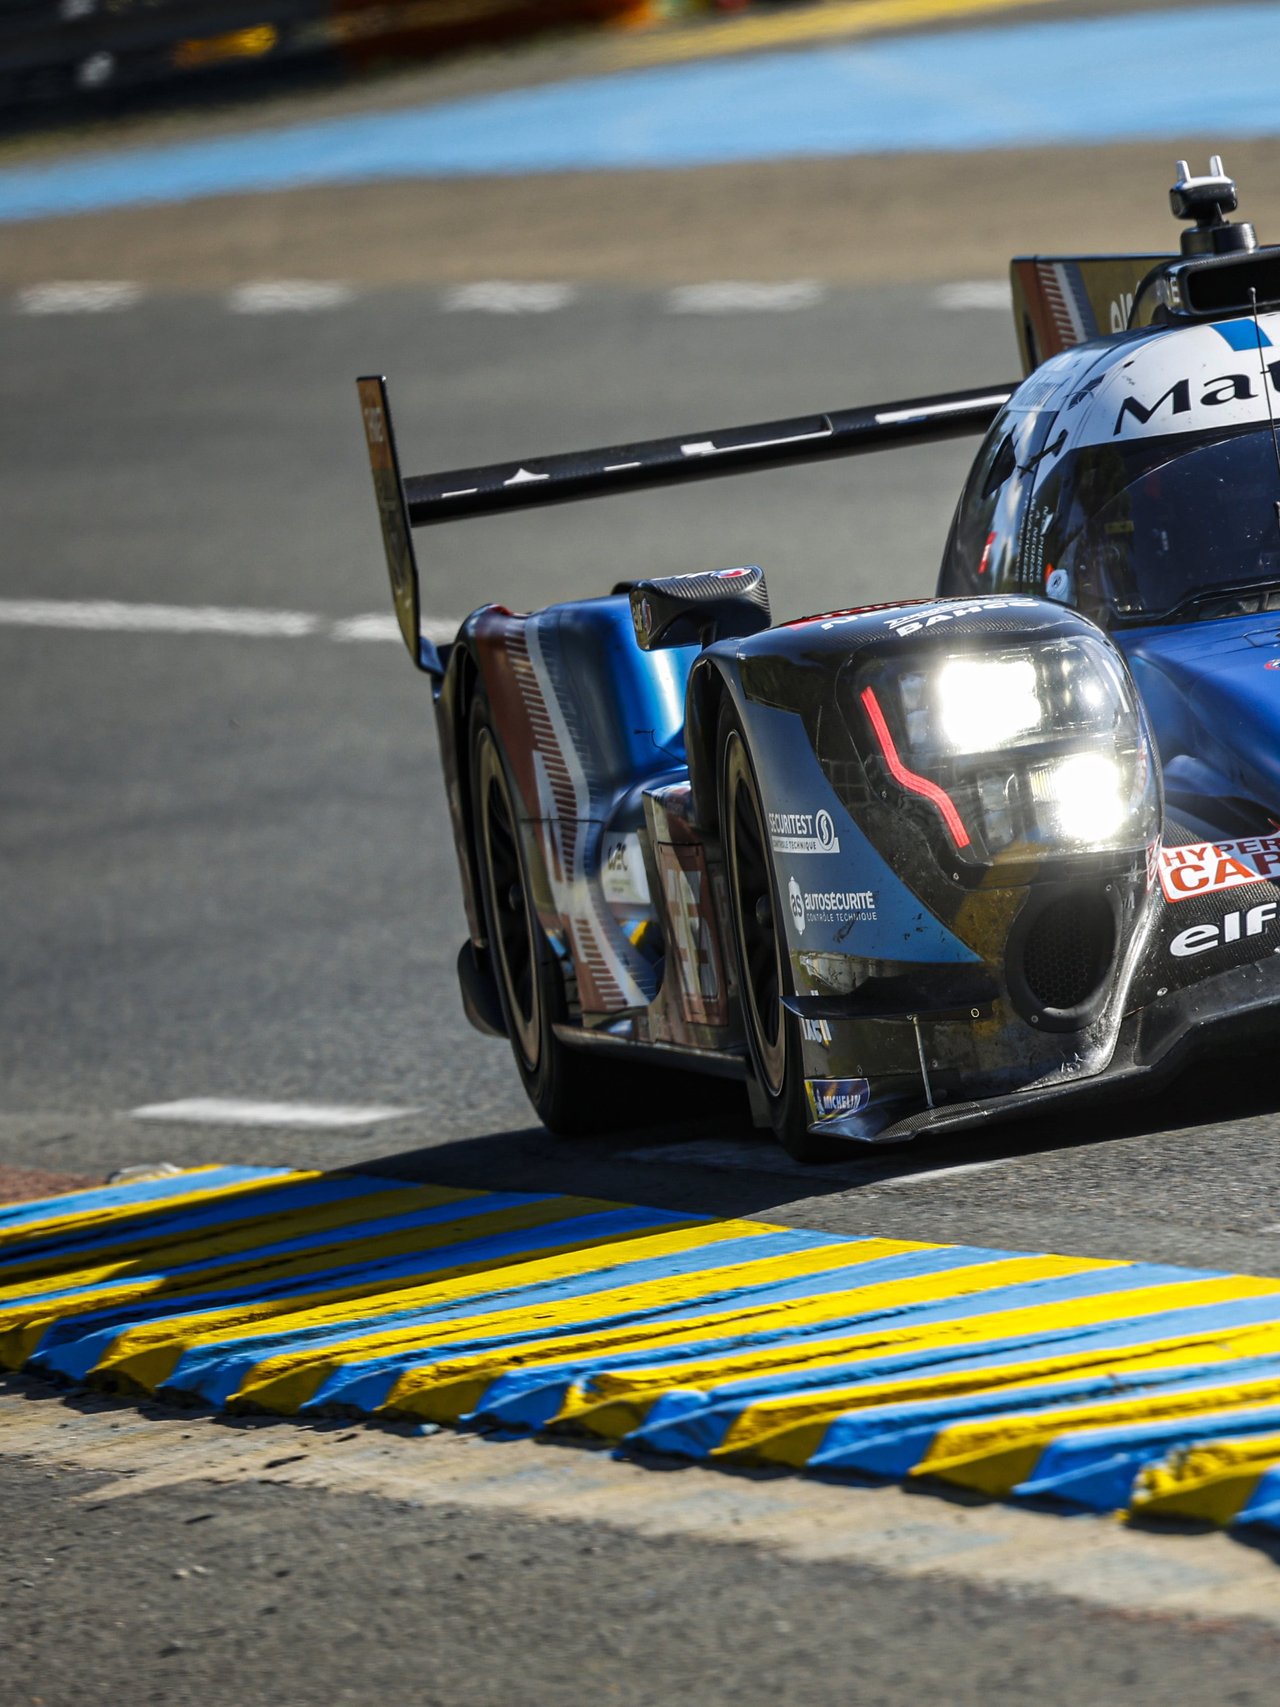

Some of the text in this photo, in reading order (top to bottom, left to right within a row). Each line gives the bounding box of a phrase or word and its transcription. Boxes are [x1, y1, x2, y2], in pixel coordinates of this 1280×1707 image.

[896, 601, 1041, 637] BAHCO
[768, 812, 813, 835] SECURITEST
[836, 911, 878, 922] TECHNIQUE
[1169, 902, 1278, 957] elf
[823, 1095, 861, 1110] MICHELIN
